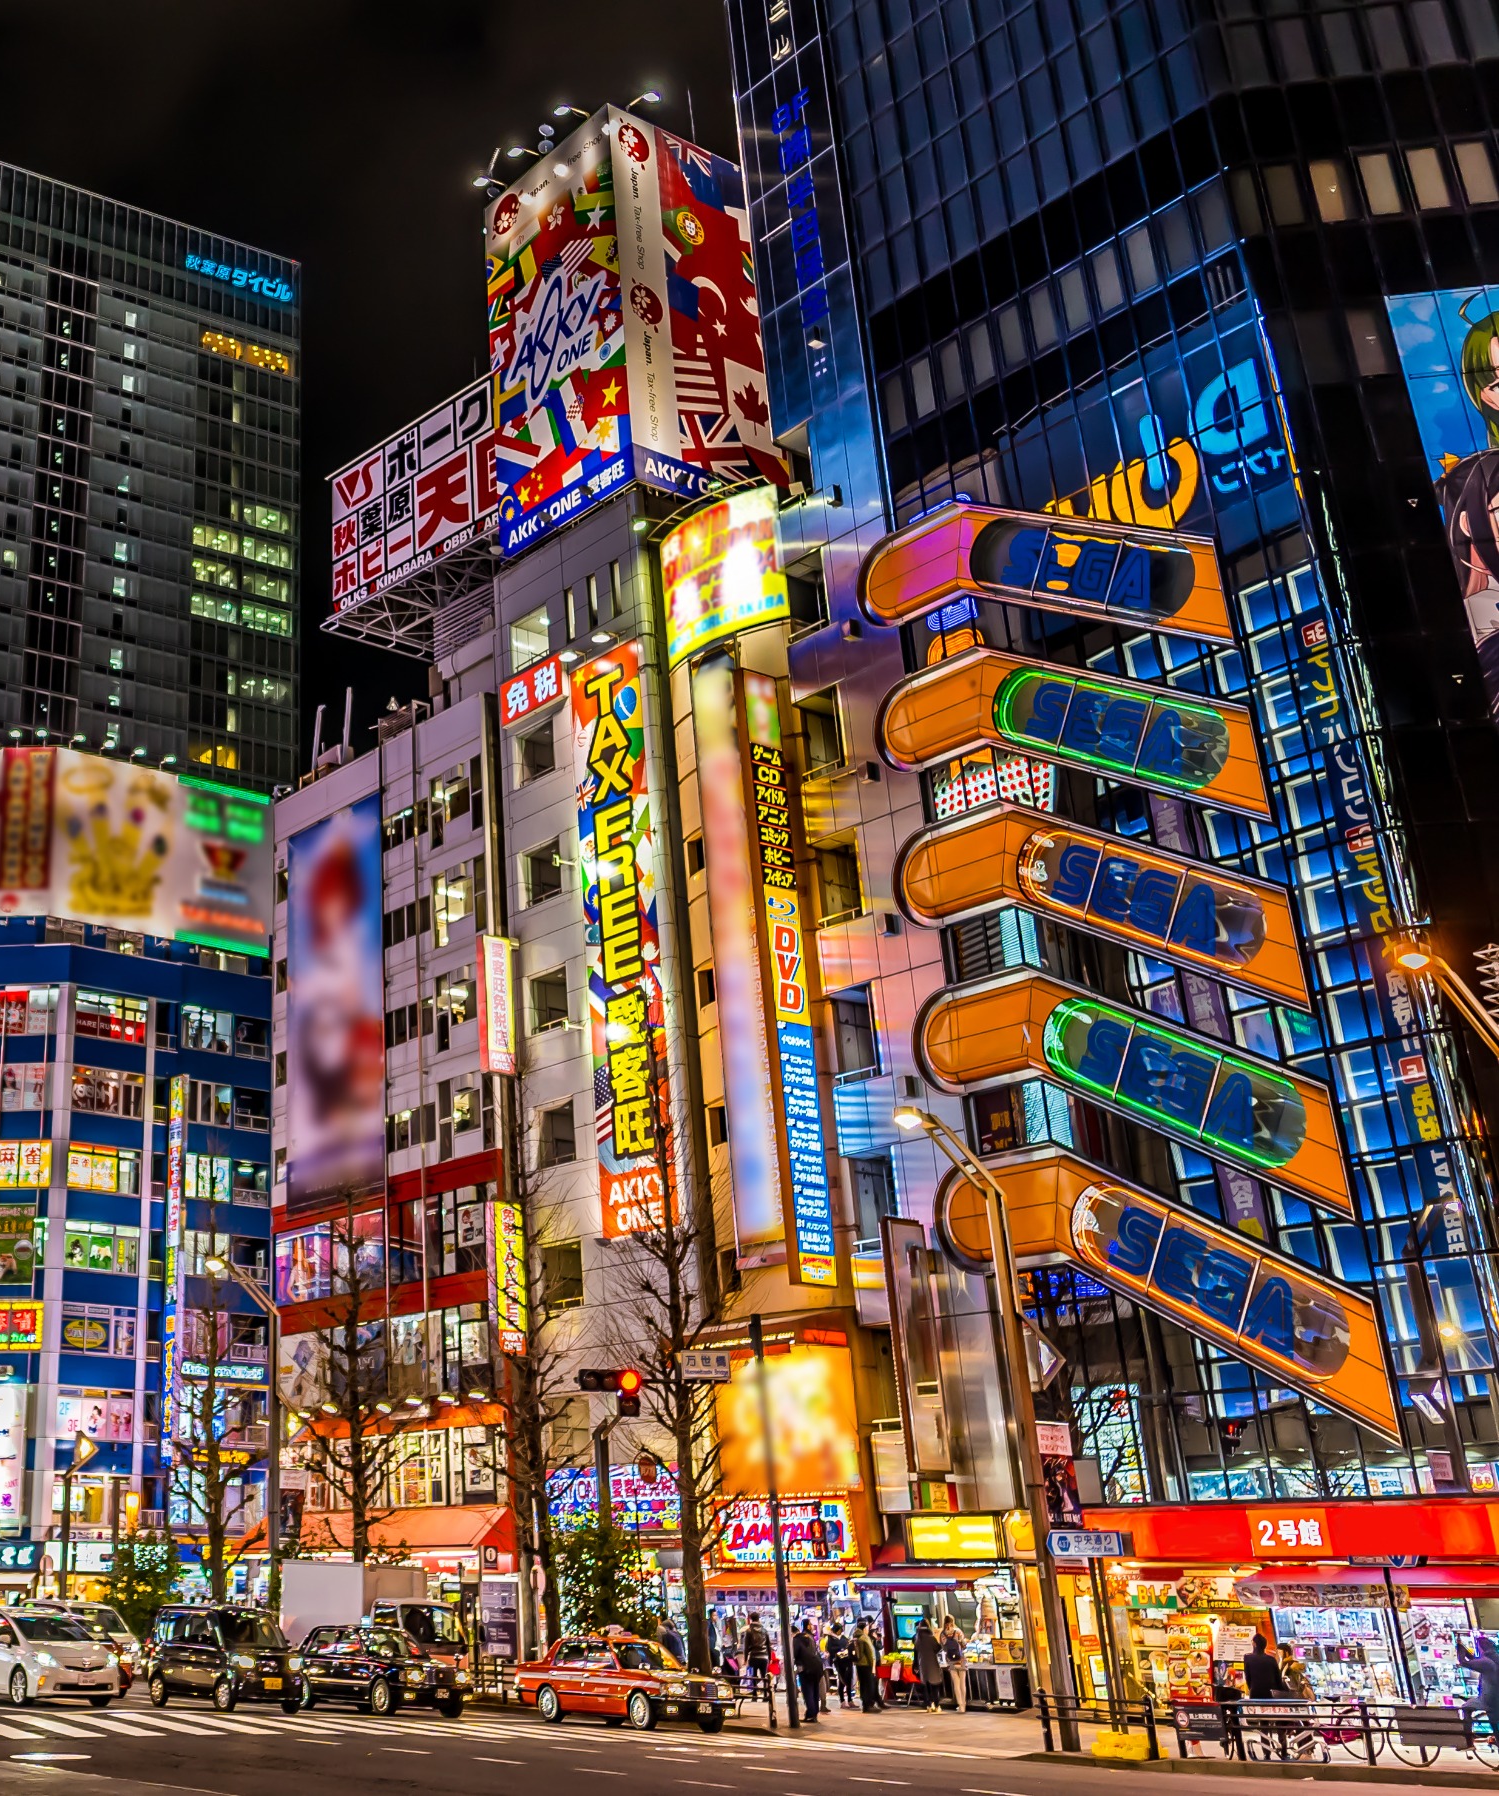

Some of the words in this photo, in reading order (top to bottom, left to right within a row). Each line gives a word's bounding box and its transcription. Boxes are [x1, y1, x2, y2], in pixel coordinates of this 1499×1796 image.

[630, 167, 640, 200] Japan.
[634, 205, 644, 247] Tax-free
[637, 246, 646, 271] Shop
[185, 253, 293, 302] 秋葉原ダイビル
[555, 328, 594, 374] ONE
[642, 331, 652, 368] Japan.
[646, 371, 657, 414] Tax-free
[650, 410, 660, 442] Shop
[333, 486, 413, 557] 秋葉原
[333, 534, 413, 598] ホビー
[333, 587, 368, 613] VOLKS
[368, 550, 433, 595] AKIHABARA
[435, 525, 475, 559] HOBBY
[1000, 526, 1152, 608] SEGA
[506, 661, 558, 719] 免税
[582, 664, 638, 809] TAX
[1024, 681, 1184, 776] SEGA
[753, 744, 782, 766] ゲーム
[757, 766, 781, 784] CD
[756, 784, 786, 807] アイドル
[757, 804, 789, 828] アニメ
[761, 826, 789, 847] コミック
[765, 847, 790, 865] ホビー
[594, 798, 643, 987] FREE
[764, 866, 794, 889] フィギュア
[1052, 845, 1217, 956] SEGA
[773, 924, 805, 1013] DVD
[490, 942, 509, 1048] 愛客旺免税店
[606, 989, 656, 1156] 愛客旺
[1077, 1017, 1256, 1152] SEGA
[608, 1174, 667, 1207] AKKY
[616, 1203, 665, 1233] ONE
[1107, 1206, 1294, 1359] SEGA
[685, 1355, 727, 1367] 万世橋
[59, 1402, 71, 1416] 2F
[1073, 1535, 1113, 1546] 中央通り
[1257, 1518, 1323, 1547] 2号館
[736, 1552, 767, 1561] MEDIA
[1136, 1583, 1157, 1606] B1
